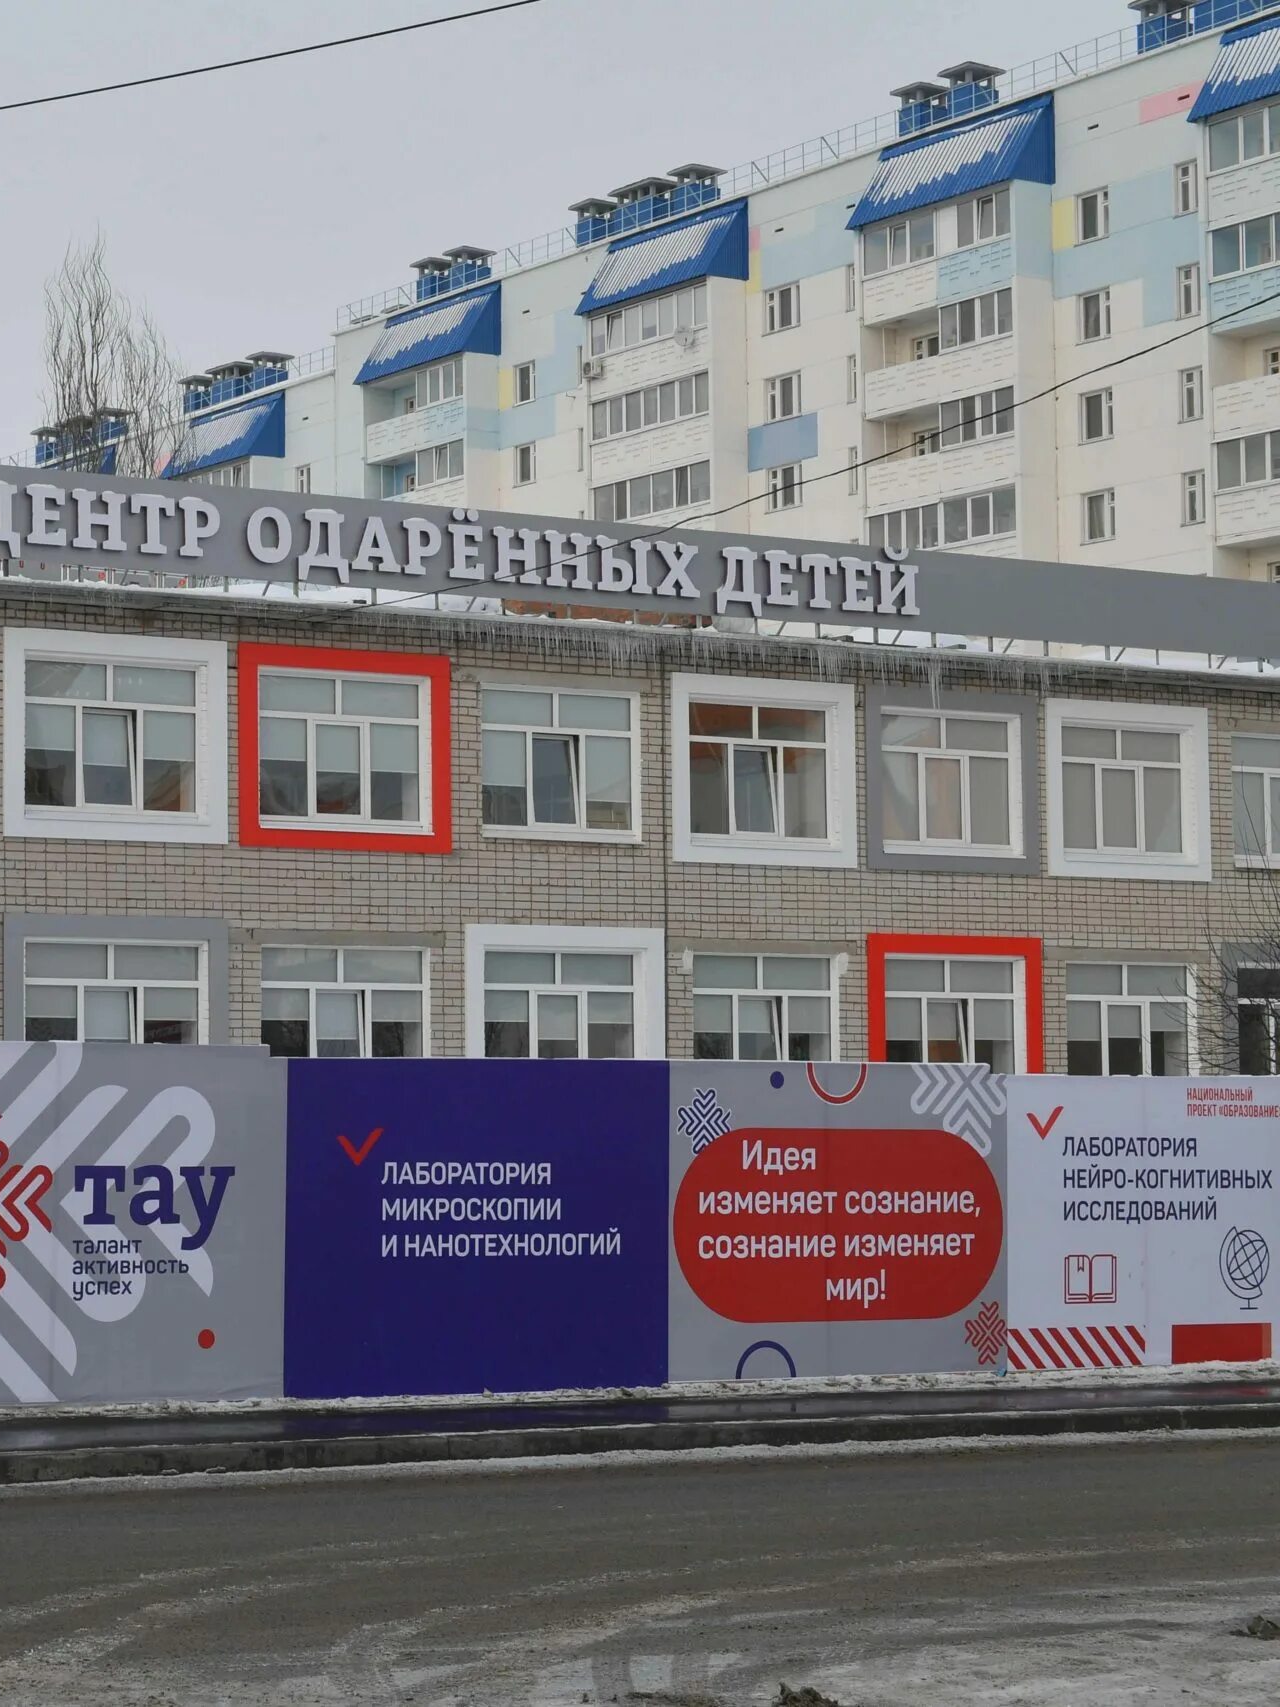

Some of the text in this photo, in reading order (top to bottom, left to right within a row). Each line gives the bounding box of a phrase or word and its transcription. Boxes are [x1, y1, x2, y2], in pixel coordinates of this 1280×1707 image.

[246, 506, 700, 600] ОДАРЁННЫХ
[716, 545, 920, 617] ДЕТЕЙ
[1187, 1086, 1253, 1102] НАЦИОНАЛЬНЫЙ
[1187, 1104, 1280, 1118] ПРОЕКТ «ОБРАЗОВАНИЕ
[741, 1139, 816, 1175] Идея
[1062, 1136, 1197, 1157] ЛАБОРАТОРИЯ
[381, 1162, 551, 1185] ЛАБОРАТОРИЯ
[1063, 1163, 1273, 1189] НЕЙРО-КОГНИТИВНЫХ
[381, 1199, 561, 1221] МИКРОСКОПИИ
[698, 1190, 980, 1217] изменяет сознание,
[1063, 1195, 1217, 1224] ИССЛЕДОВАНИЙ
[73, 1239, 142, 1254] талант
[381, 1227, 621, 1257] И НАНОТЕХНОЛОГИЙ
[698, 1232, 975, 1259] сознание изменяет
[72, 1258, 189, 1275] активность
[72, 1280, 132, 1300] успех
[826, 1269, 886, 1308] мир!
